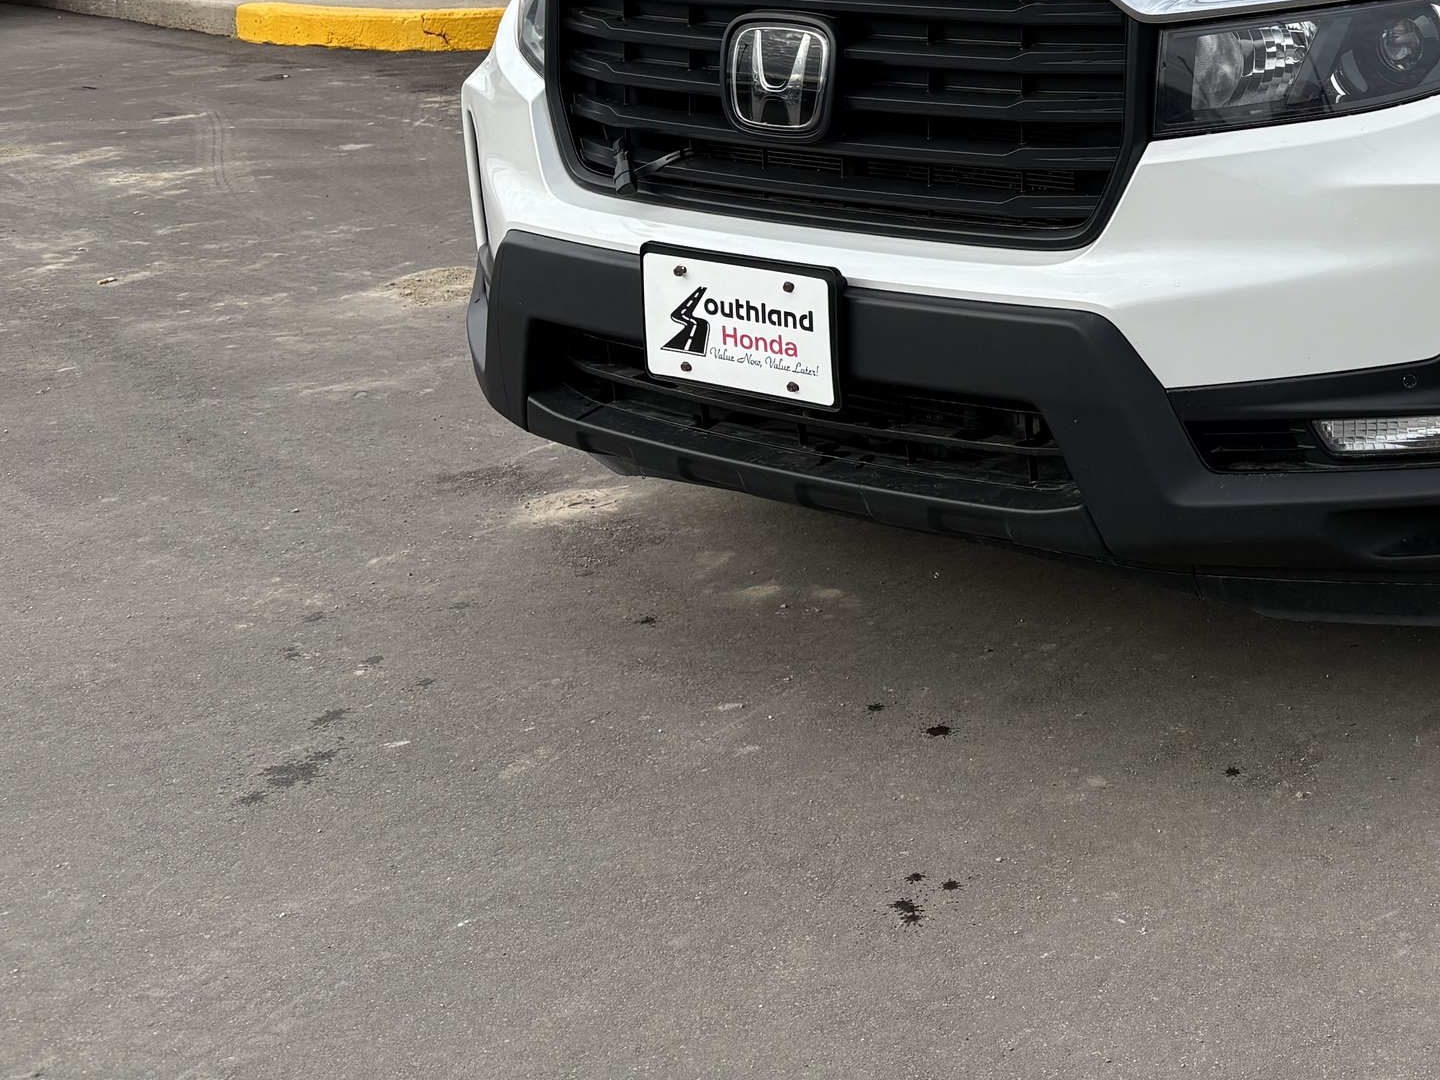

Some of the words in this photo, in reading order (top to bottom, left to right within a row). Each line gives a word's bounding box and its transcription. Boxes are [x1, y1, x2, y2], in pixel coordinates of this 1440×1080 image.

[721, 324, 799, 358] Honda
[709, 346, 735, 362] Value
[737, 352, 763, 368] Now,
[764, 356, 791, 372] Value
[791, 361, 819, 377] Later!
